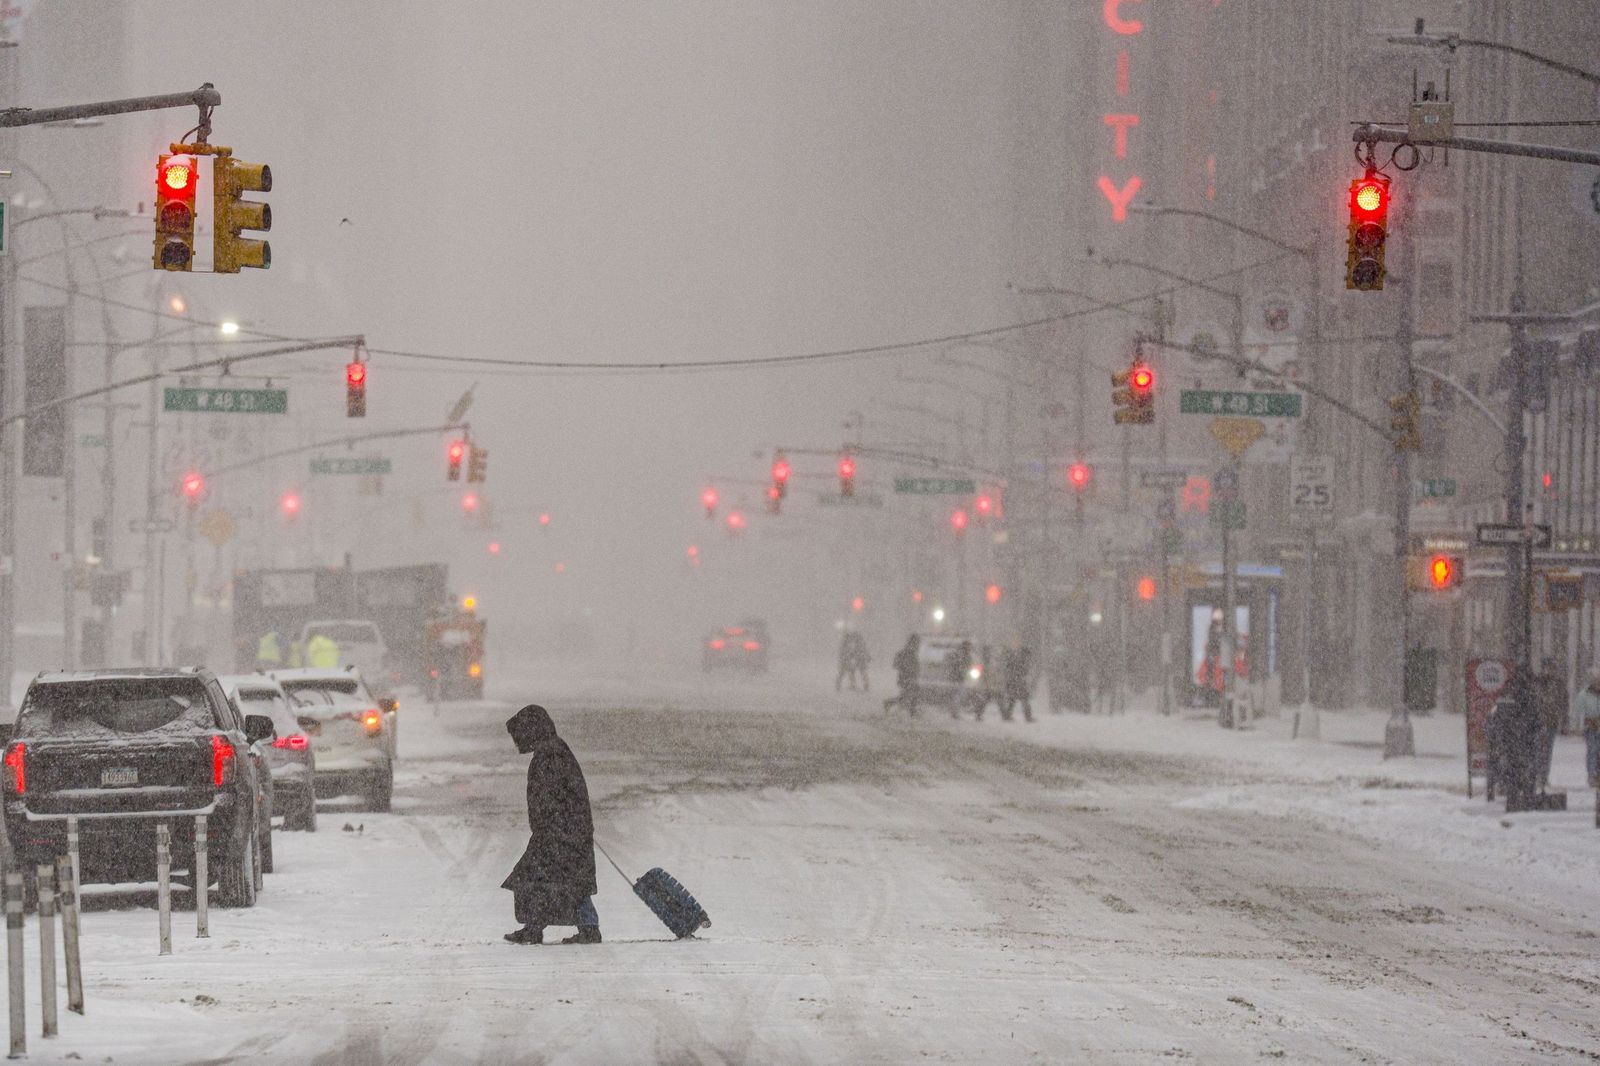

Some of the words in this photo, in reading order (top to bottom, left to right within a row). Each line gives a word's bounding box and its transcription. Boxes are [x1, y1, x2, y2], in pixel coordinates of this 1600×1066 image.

[1096, 0, 1143, 223] CITY
[197, 391, 208, 409] W
[1212, 395, 1222, 411] W
[1295, 484, 1330, 505] 25
